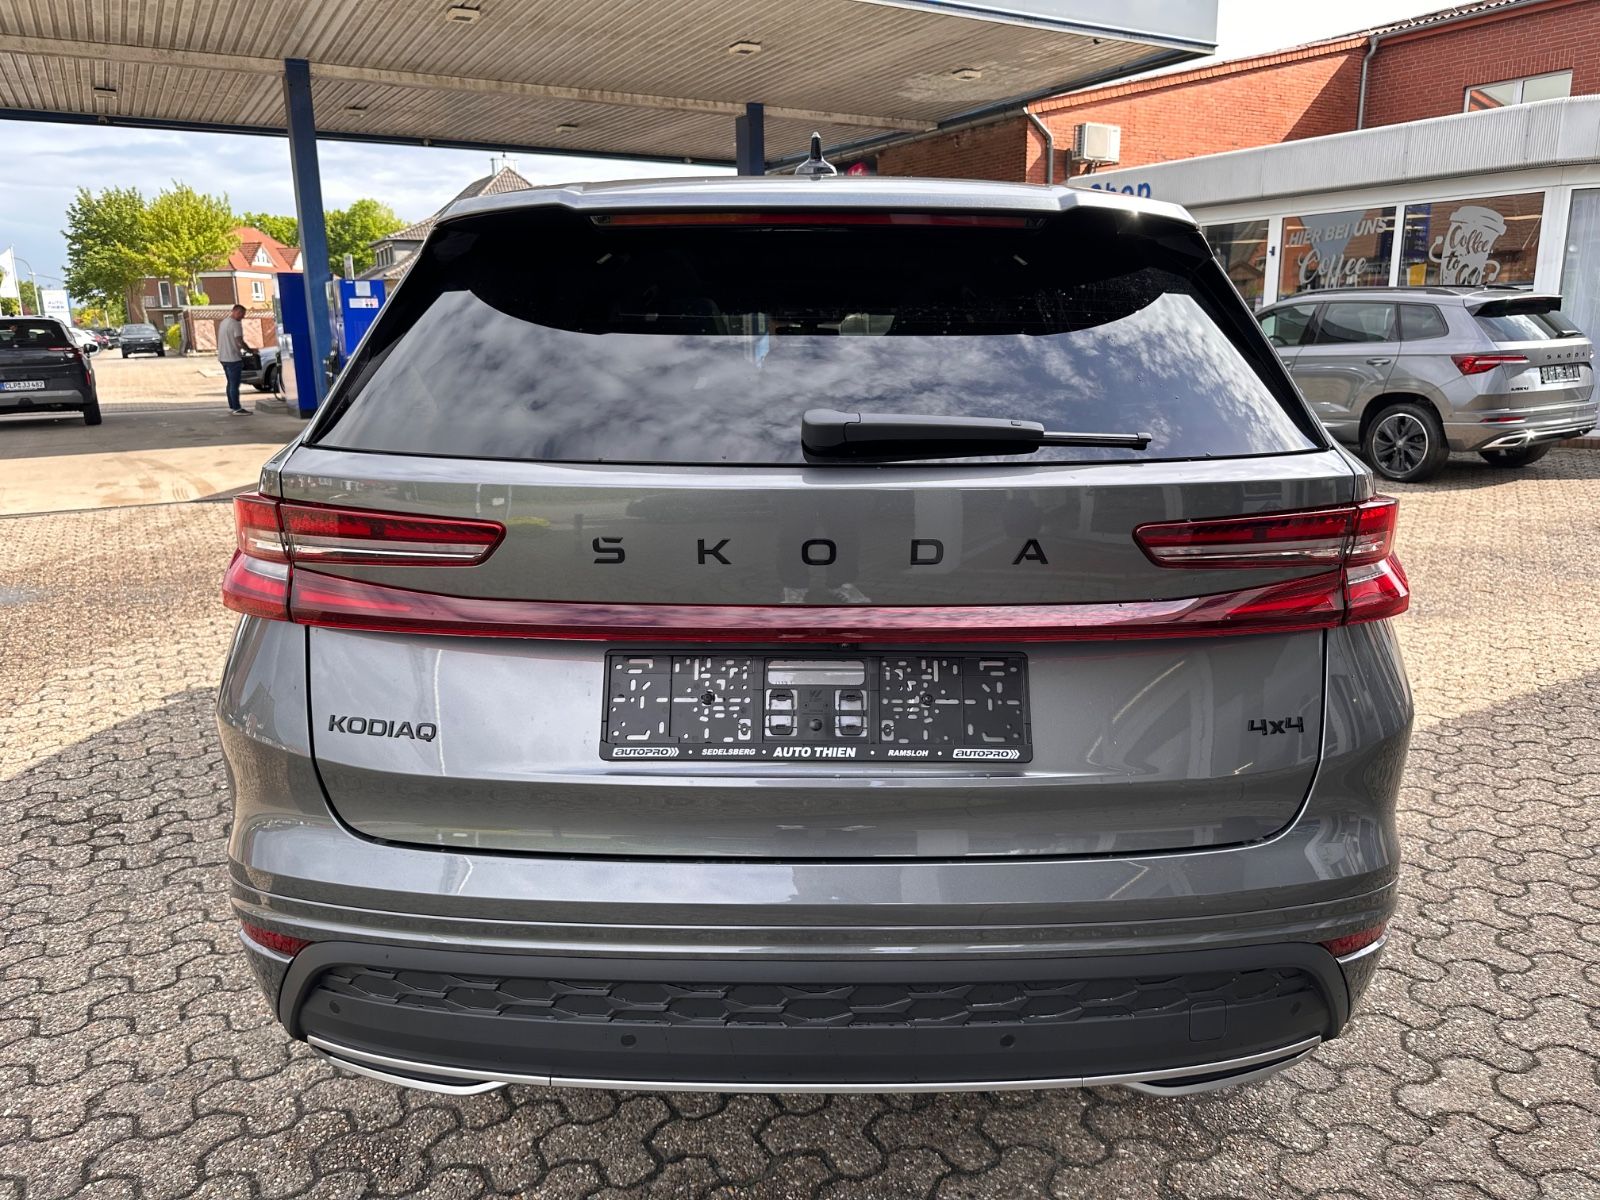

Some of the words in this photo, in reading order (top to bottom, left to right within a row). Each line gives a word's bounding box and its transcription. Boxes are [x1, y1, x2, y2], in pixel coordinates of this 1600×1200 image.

[1289, 227, 1321, 245] HIER
[1325, 223, 1350, 241] BEI
[1354, 216, 1388, 237] UNS
[1449, 225, 1489, 255] Coffee
[1298, 249, 1367, 290] Coffee
[1443, 251, 1463, 271] to
[328, 714, 437, 742] KODIAQ
[1247, 716, 1304, 736] 4x4
[701, 748, 756, 756] SEDELSBERG
[773, 747, 812, 757] AUTO
[814, 747, 857, 758] THIEN
[887, 749, 929, 757] RAMSLOH
